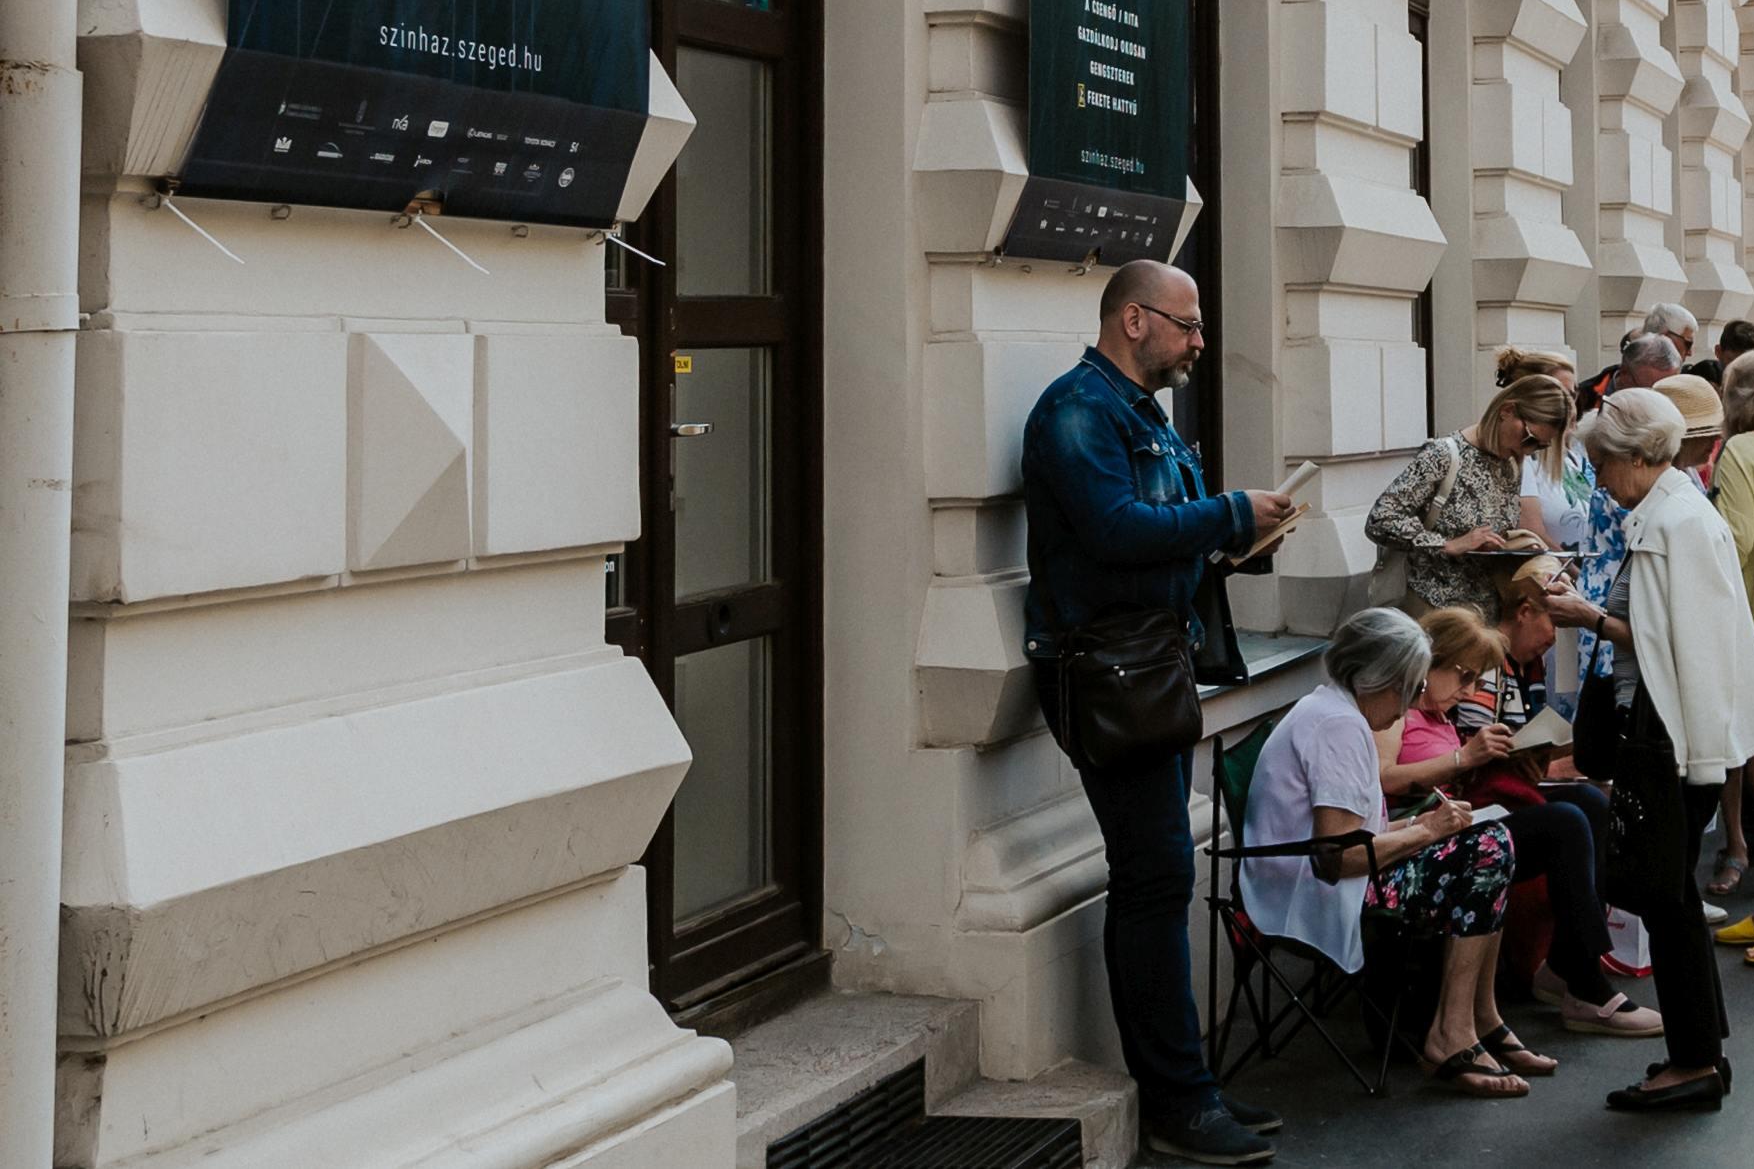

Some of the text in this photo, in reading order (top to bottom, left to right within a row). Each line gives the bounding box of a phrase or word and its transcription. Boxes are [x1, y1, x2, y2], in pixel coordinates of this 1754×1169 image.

[1123, 11, 1139, 28] RITA
[379, 21, 543, 73] szinhaz.szeged.hu
[1090, 60, 1135, 86] GENGSZTEREK
[1087, 89, 1110, 110] FEKETE
